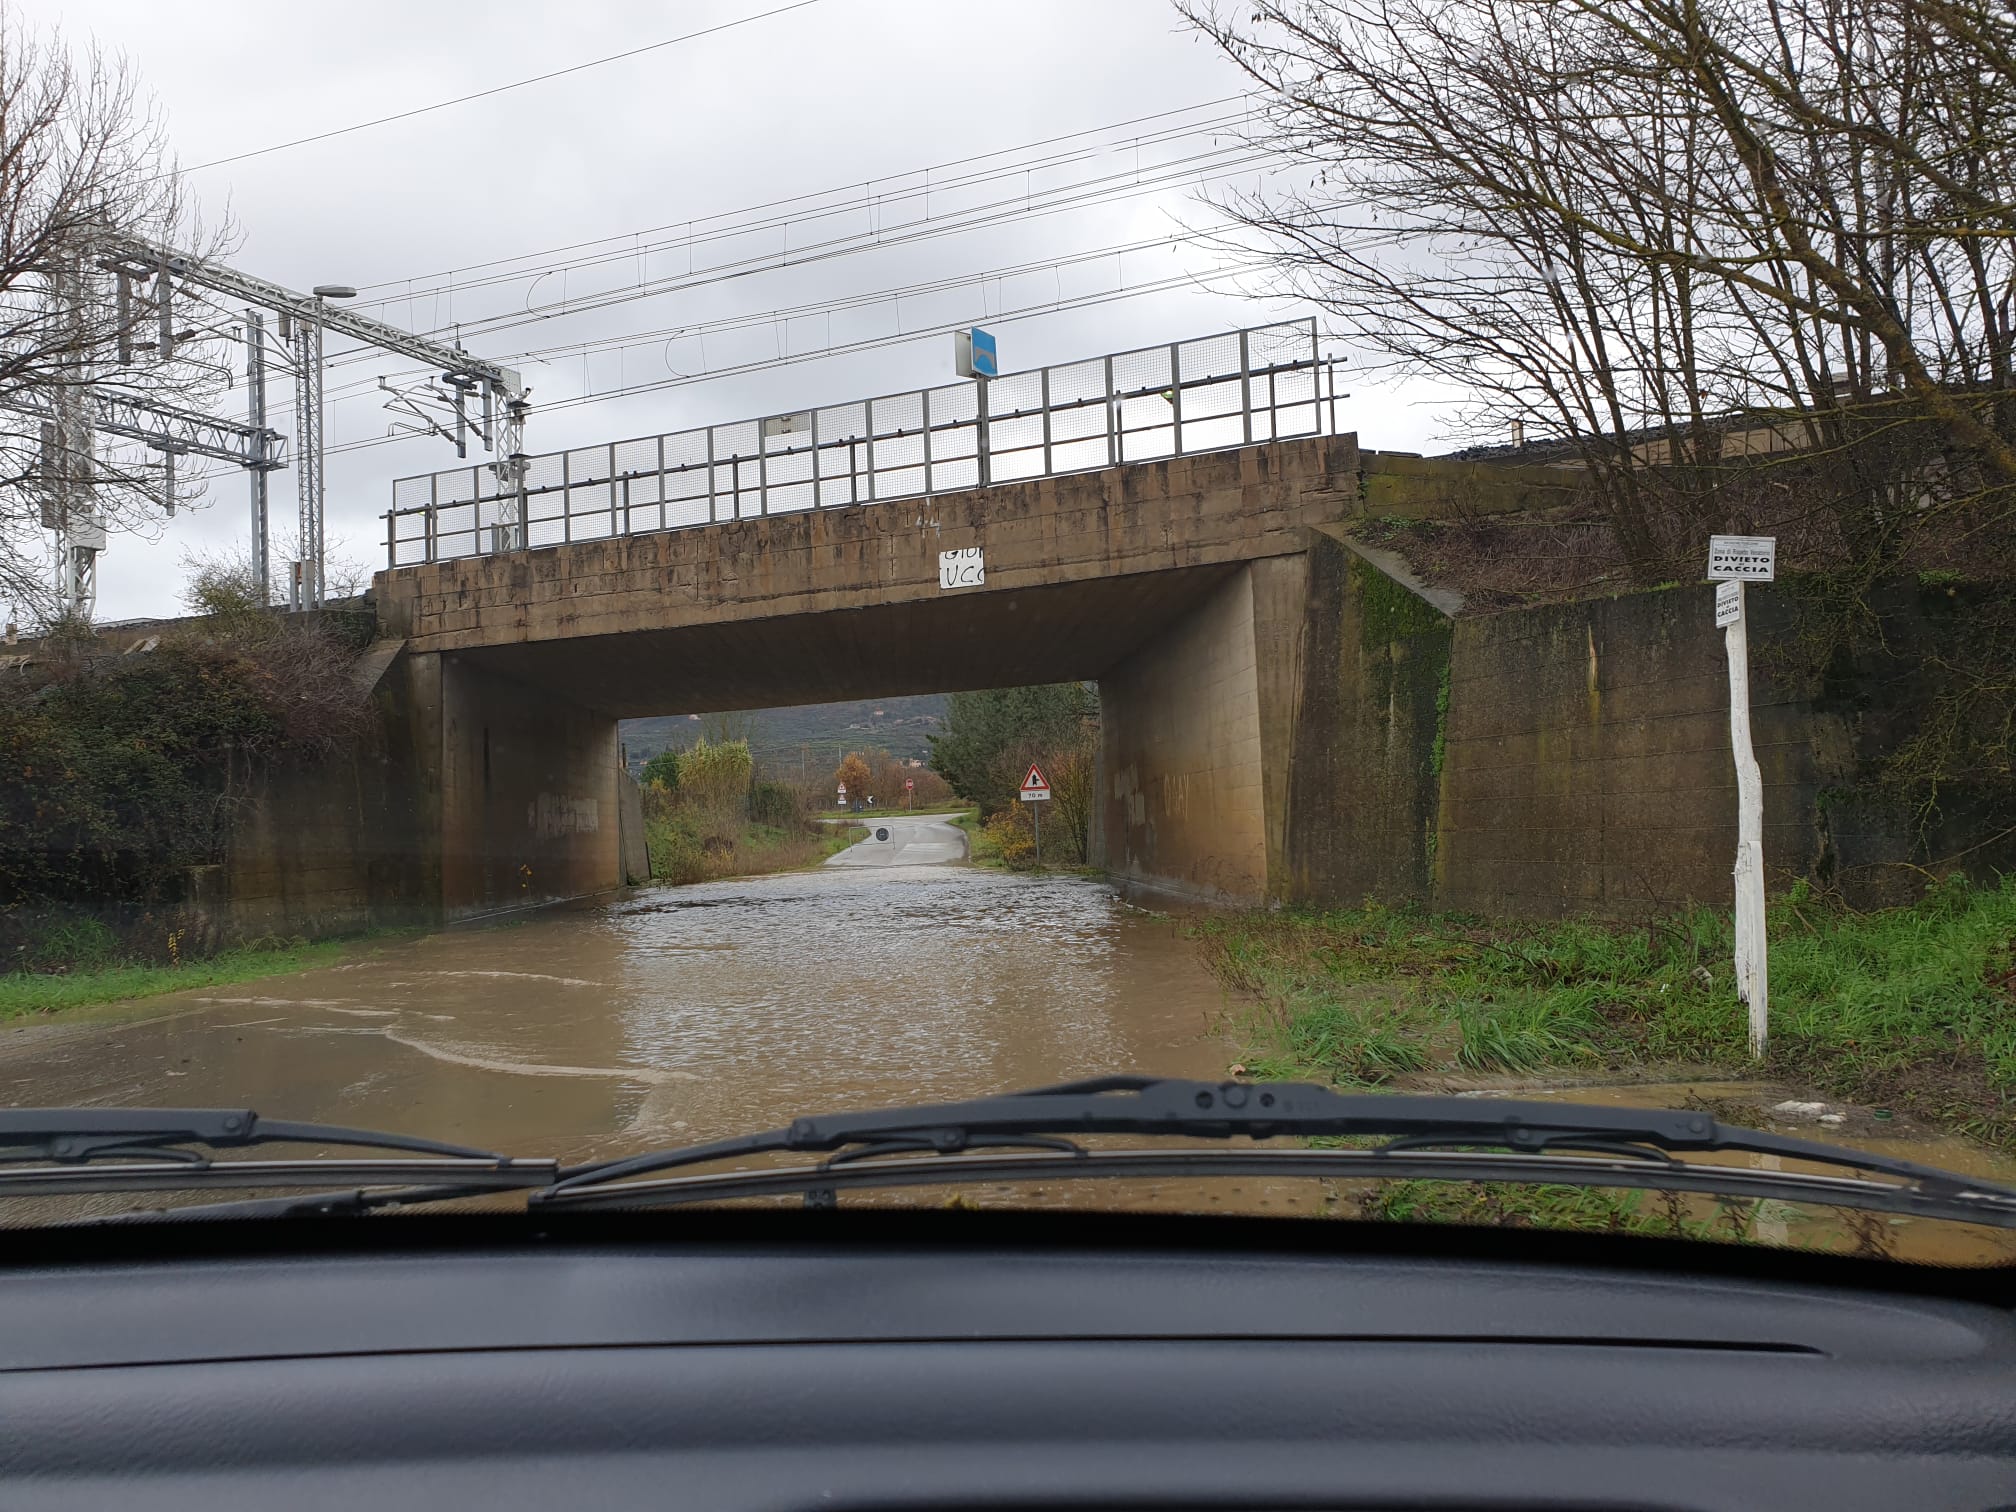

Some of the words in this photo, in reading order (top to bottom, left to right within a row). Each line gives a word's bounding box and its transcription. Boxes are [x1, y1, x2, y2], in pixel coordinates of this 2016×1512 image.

[1714, 555, 1770, 563] DIVIETO
[1713, 565, 1769, 573] CACCIA
[1717, 596, 1738, 608] DIVIETO
[1717, 606, 1738, 617] CACCIA
